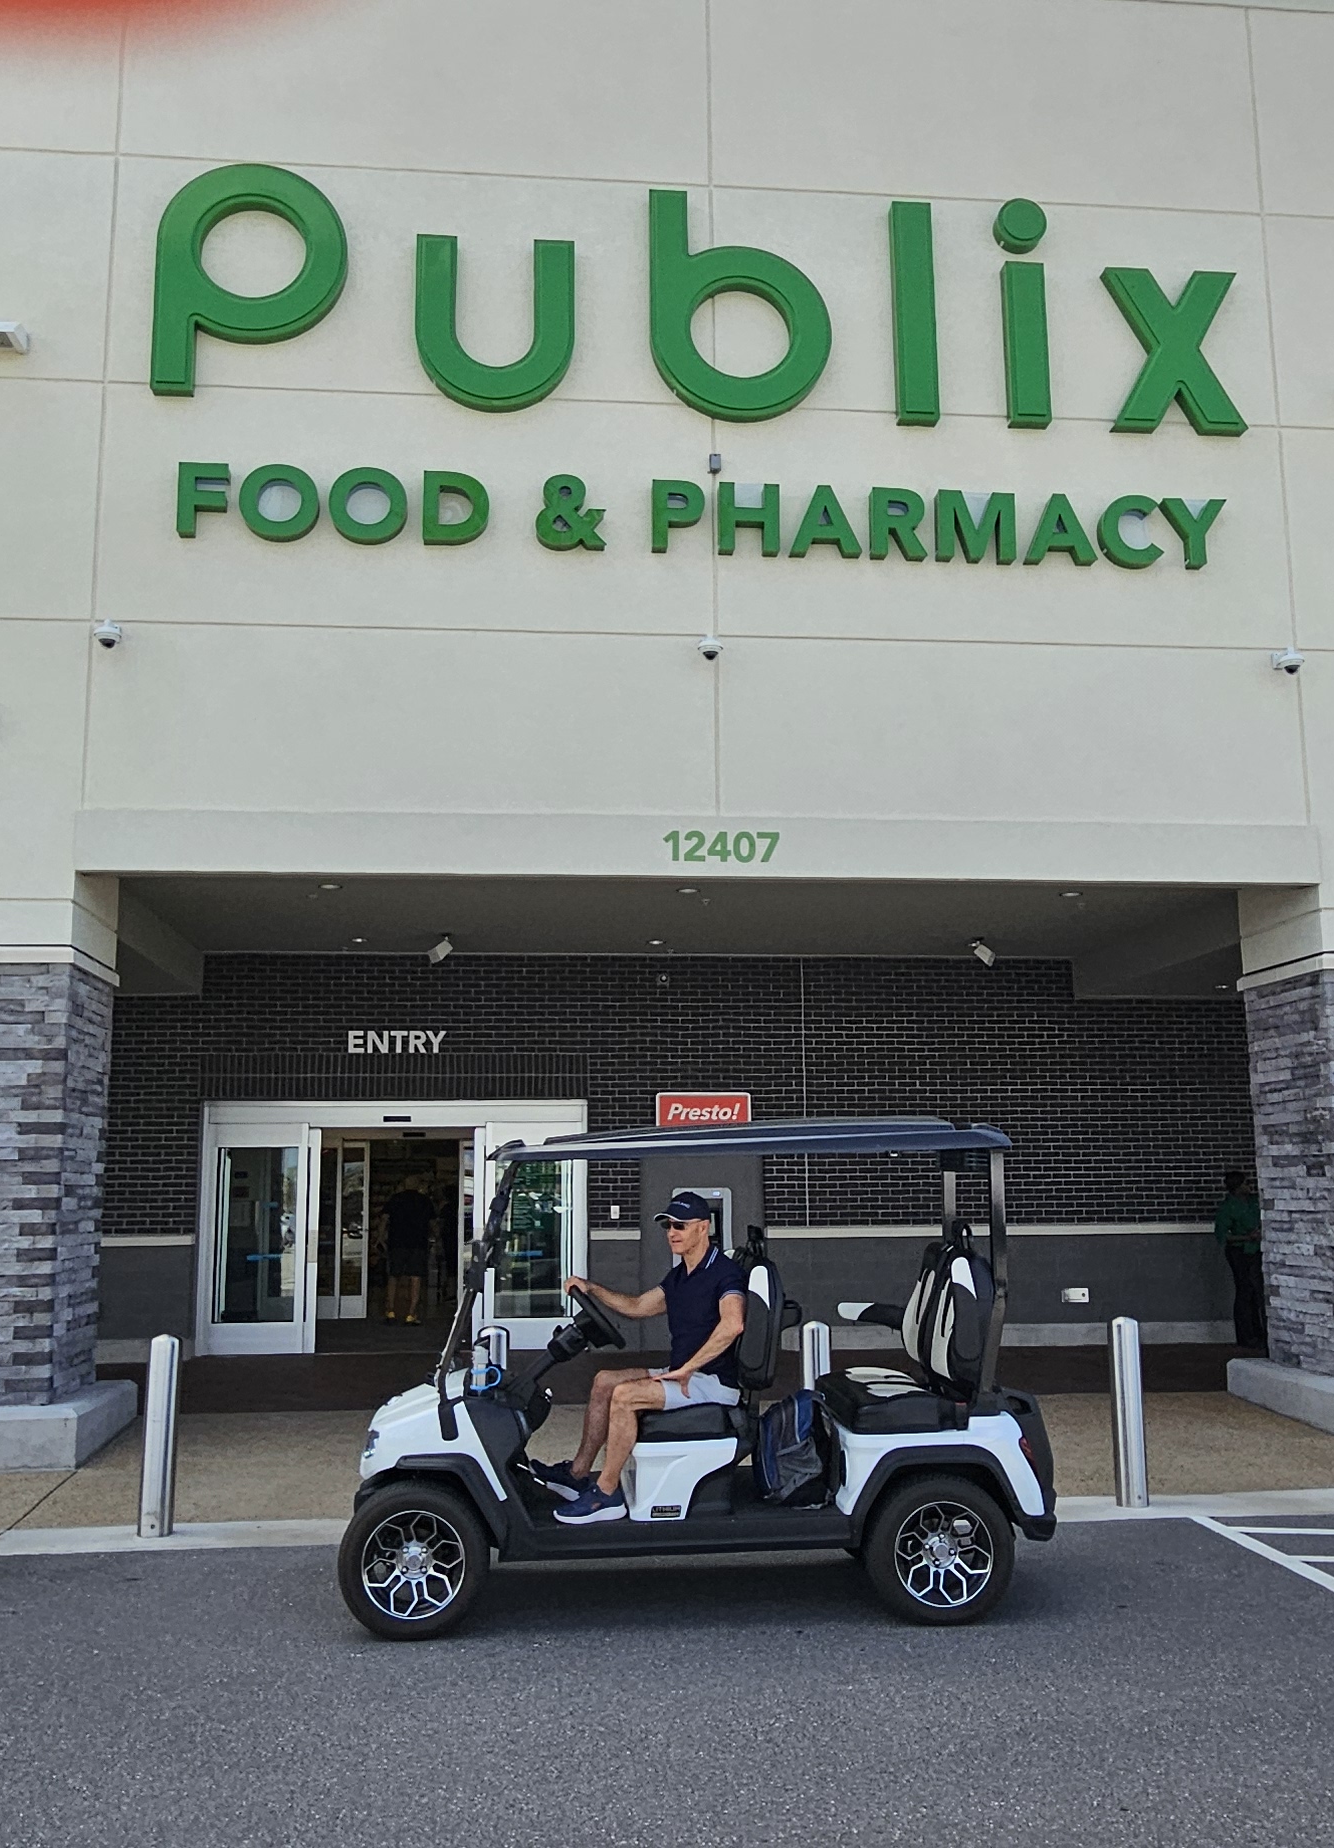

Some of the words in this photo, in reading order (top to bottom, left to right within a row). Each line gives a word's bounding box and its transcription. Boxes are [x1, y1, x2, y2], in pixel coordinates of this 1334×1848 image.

[150, 163, 1247, 436] Publix
[176, 461, 490, 545] FOOD
[535, 473, 607, 551] &
[651, 478, 1226, 570] PHARMACY
[662, 830, 780, 863] 12407
[348, 1030, 447, 1054] ENTRY
[667, 1102, 741, 1121] Presto!
